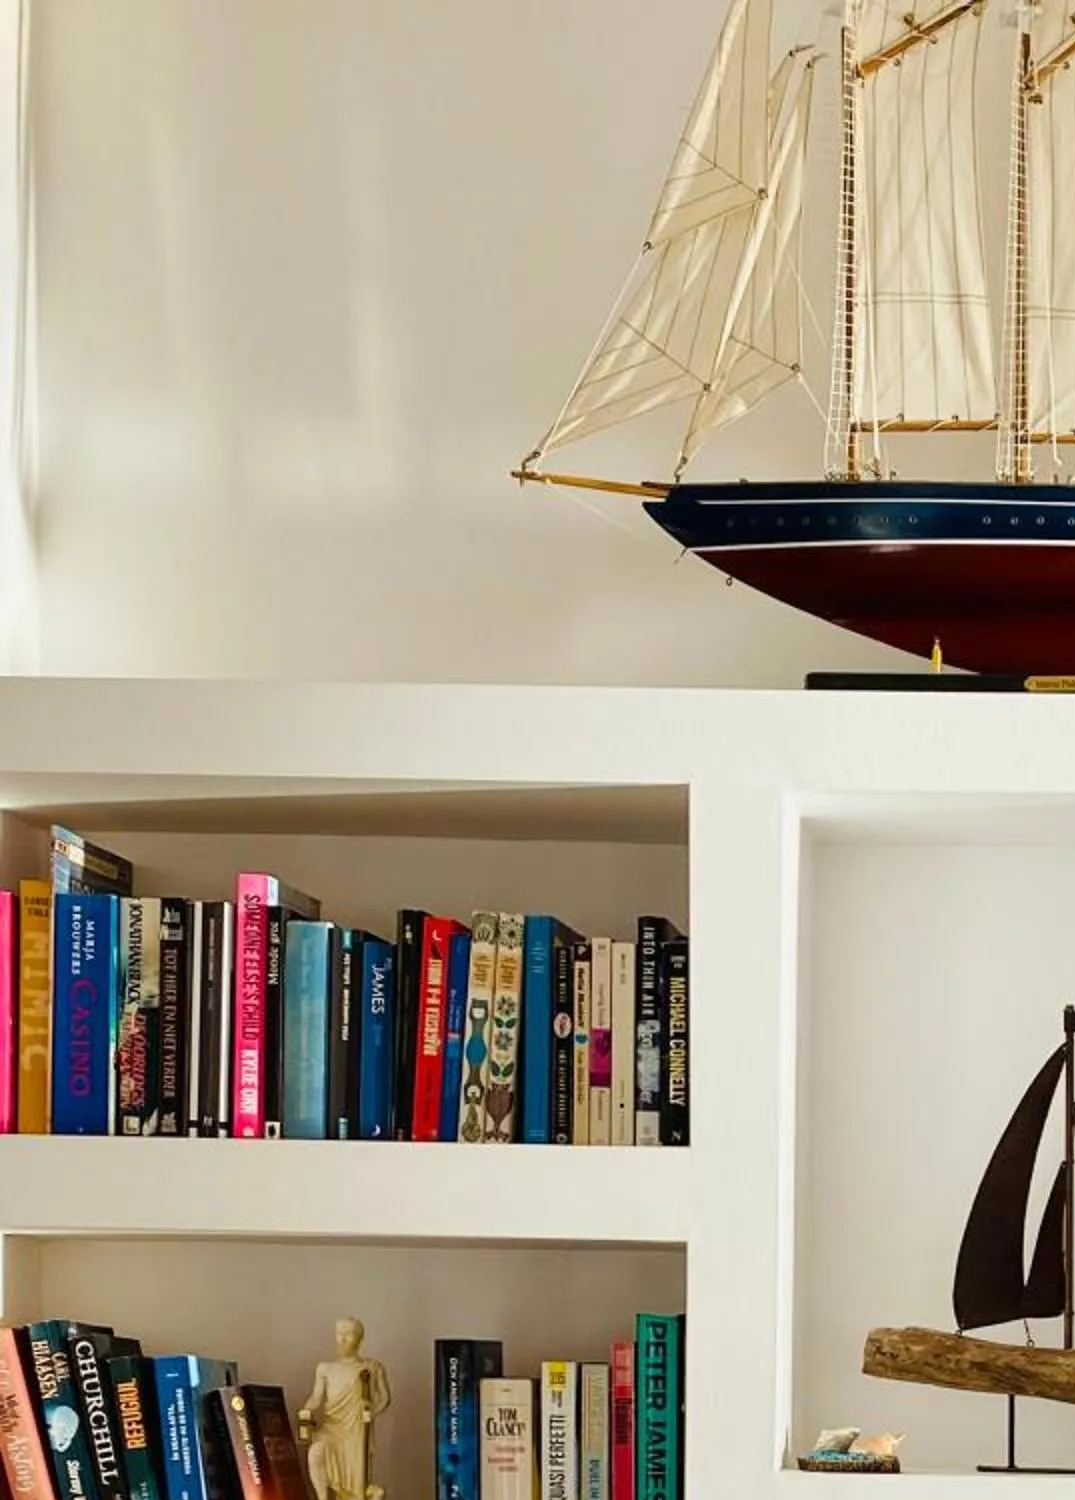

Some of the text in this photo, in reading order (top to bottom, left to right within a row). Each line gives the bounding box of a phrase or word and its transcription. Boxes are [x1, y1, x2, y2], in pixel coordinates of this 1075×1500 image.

[70, 904, 82, 976] BROUWERS
[84, 919, 96, 961] MARJA
[128, 902, 143, 969] JONATHAN
[371, 968, 386, 1014] JAMES
[641, 926, 656, 1016] INTO THIN AIR
[69, 978, 97, 1098] CASINO
[161, 948, 178, 1098] TOT HIER EN NIET VERDER
[668, 976, 687, 1107] MICHAEL CONNELLY
[31, 1339, 59, 1399] HIAASEN
[51, 1351, 71, 1383] CARL
[645, 1320, 668, 1411] PETER
[75, 1339, 119, 1486] CHURCHILL
[485, 1416, 527, 1437] CLANCY
[497, 1407, 518, 1421] TOM
[549, 1414, 567, 1467] PERFETTI
[65, 1459, 83, 1495] Stormy
